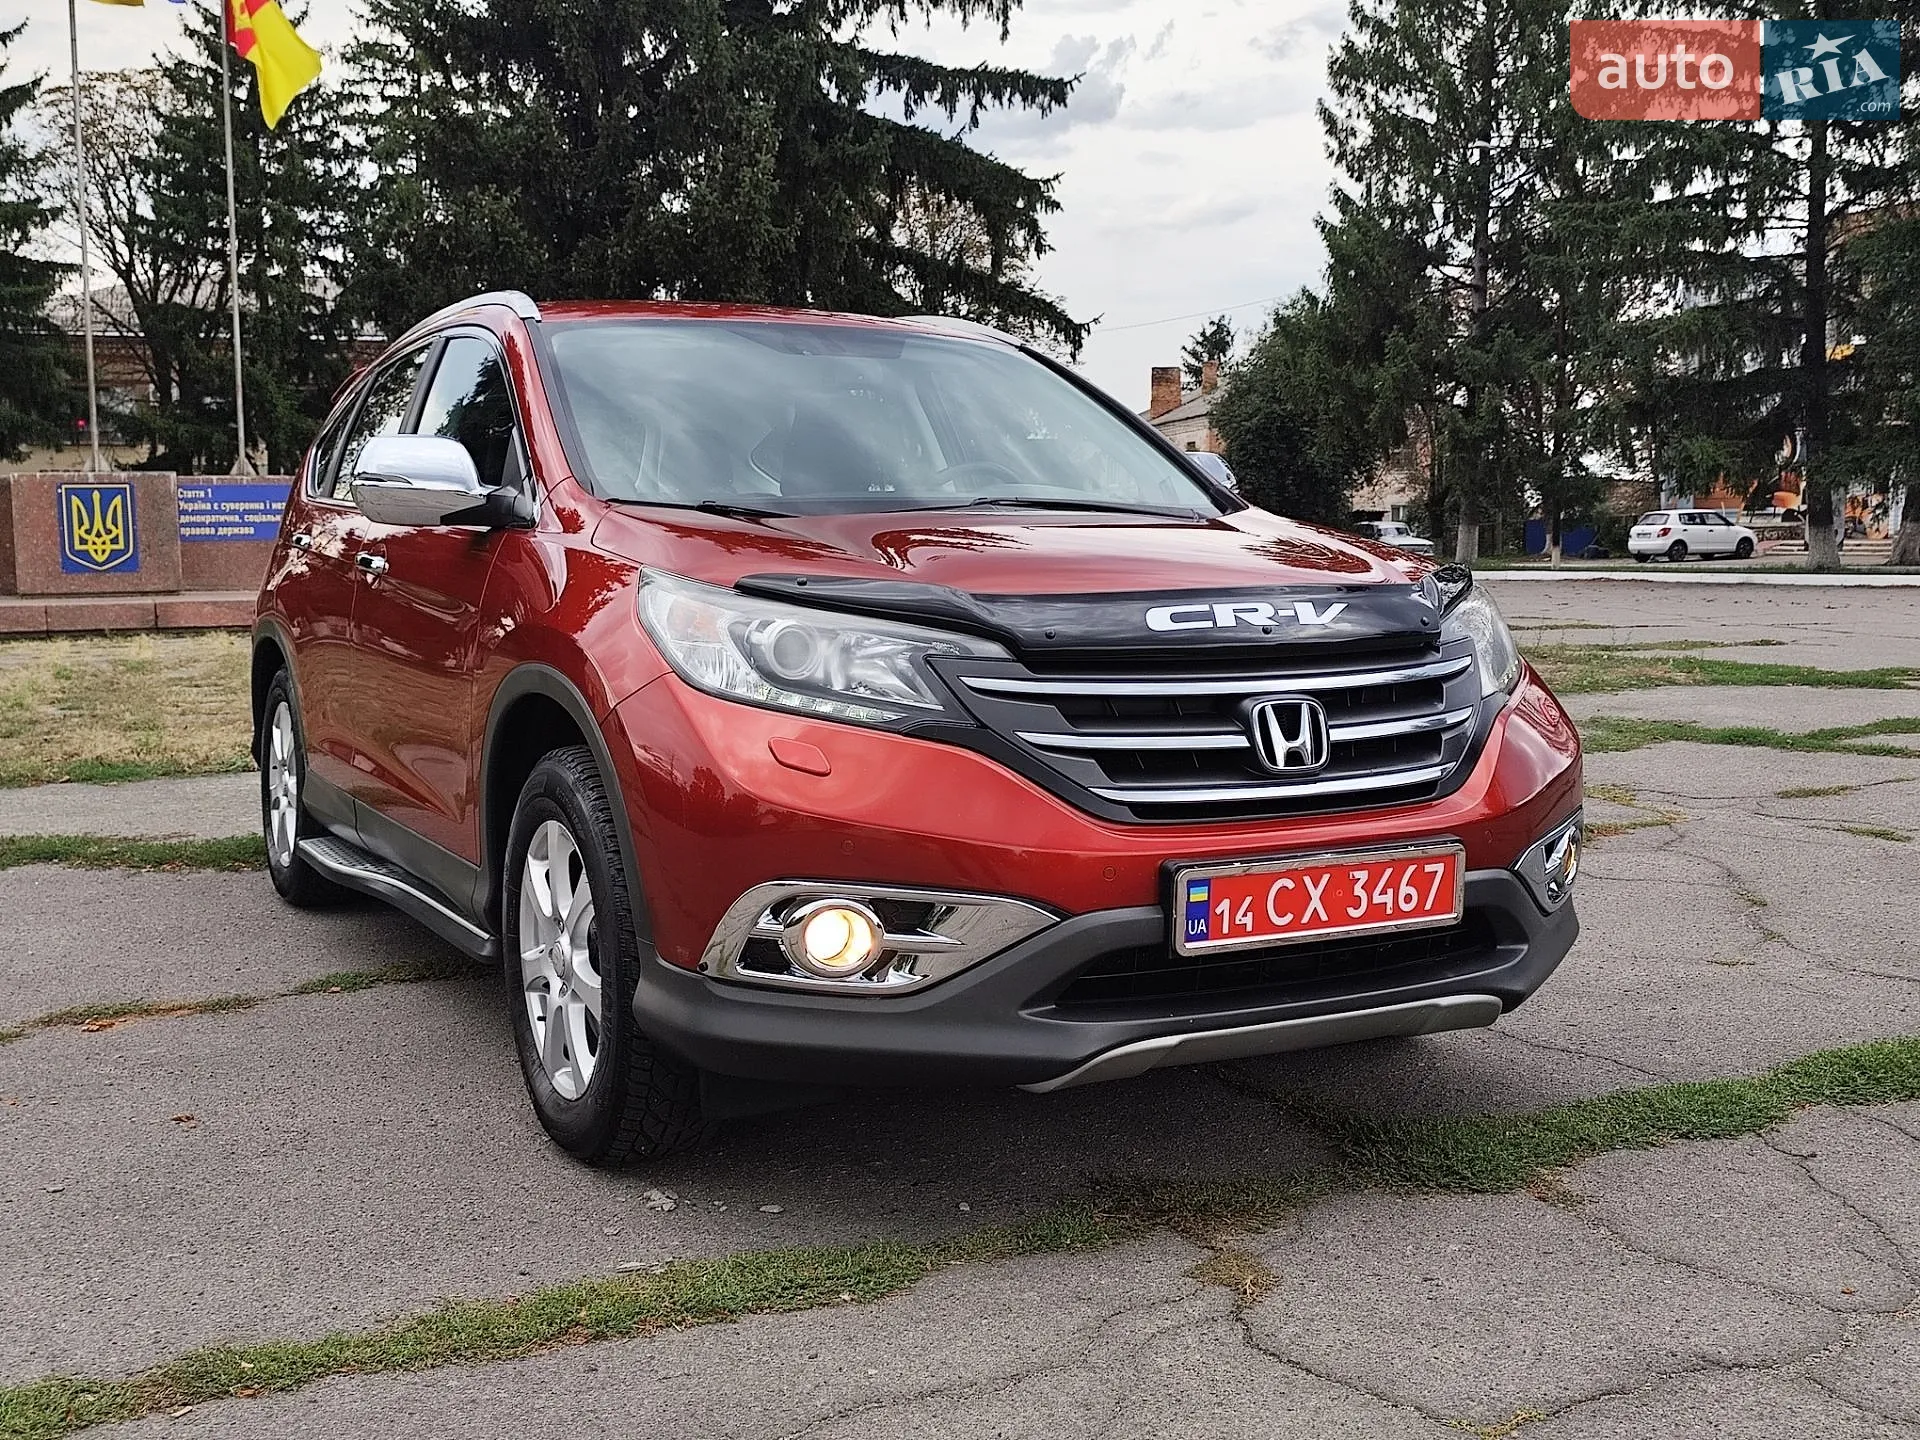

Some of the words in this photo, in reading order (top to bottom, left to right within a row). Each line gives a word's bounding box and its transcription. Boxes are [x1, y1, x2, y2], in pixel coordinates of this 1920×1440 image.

[178, 487, 205, 499] Стаття
[207, 487, 212, 498] 1
[179, 500, 211, 512] Україна
[213, 502, 219, 510] є
[221, 502, 265, 512] суверенна
[266, 500, 270, 509] і
[180, 526, 215, 537] правова
[217, 526, 254, 537] держава
[1145, 601, 1350, 632] CR-V
[1214, 895, 1254, 935] 14
[1345, 862, 1446, 919] 3467
[1187, 918, 1207, 935] UA
